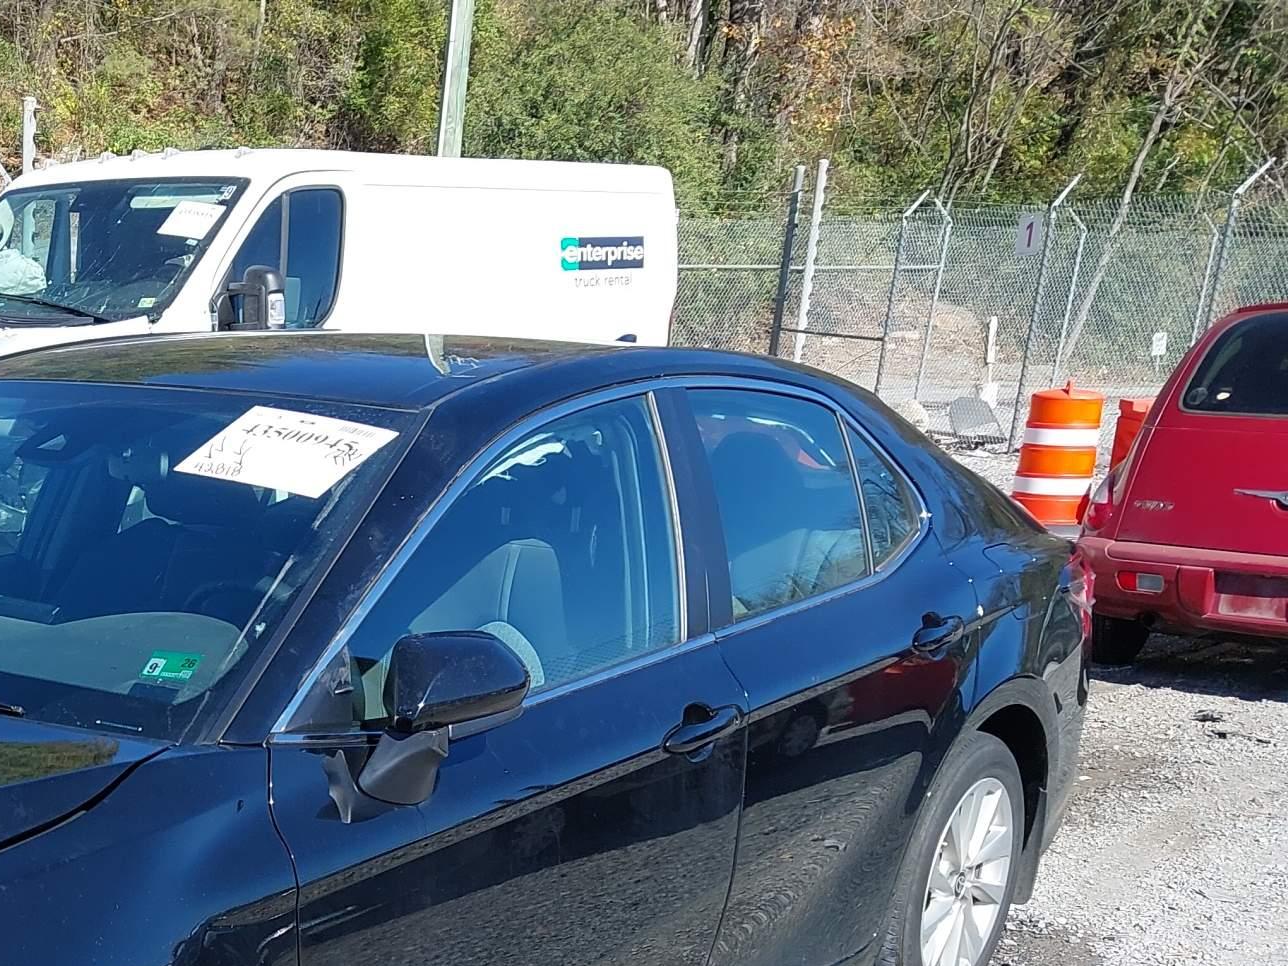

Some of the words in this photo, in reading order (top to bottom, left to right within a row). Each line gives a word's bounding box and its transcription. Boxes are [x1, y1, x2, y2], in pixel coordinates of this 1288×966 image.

[1026, 221, 1034, 248] 1
[562, 240, 644, 266] enterprise
[574, 275, 601, 288] truck
[604, 274, 633, 287] rental
[242, 424, 360, 454] 43500945
[147, 663, 158, 674] 9
[181, 658, 197, 669] 26
